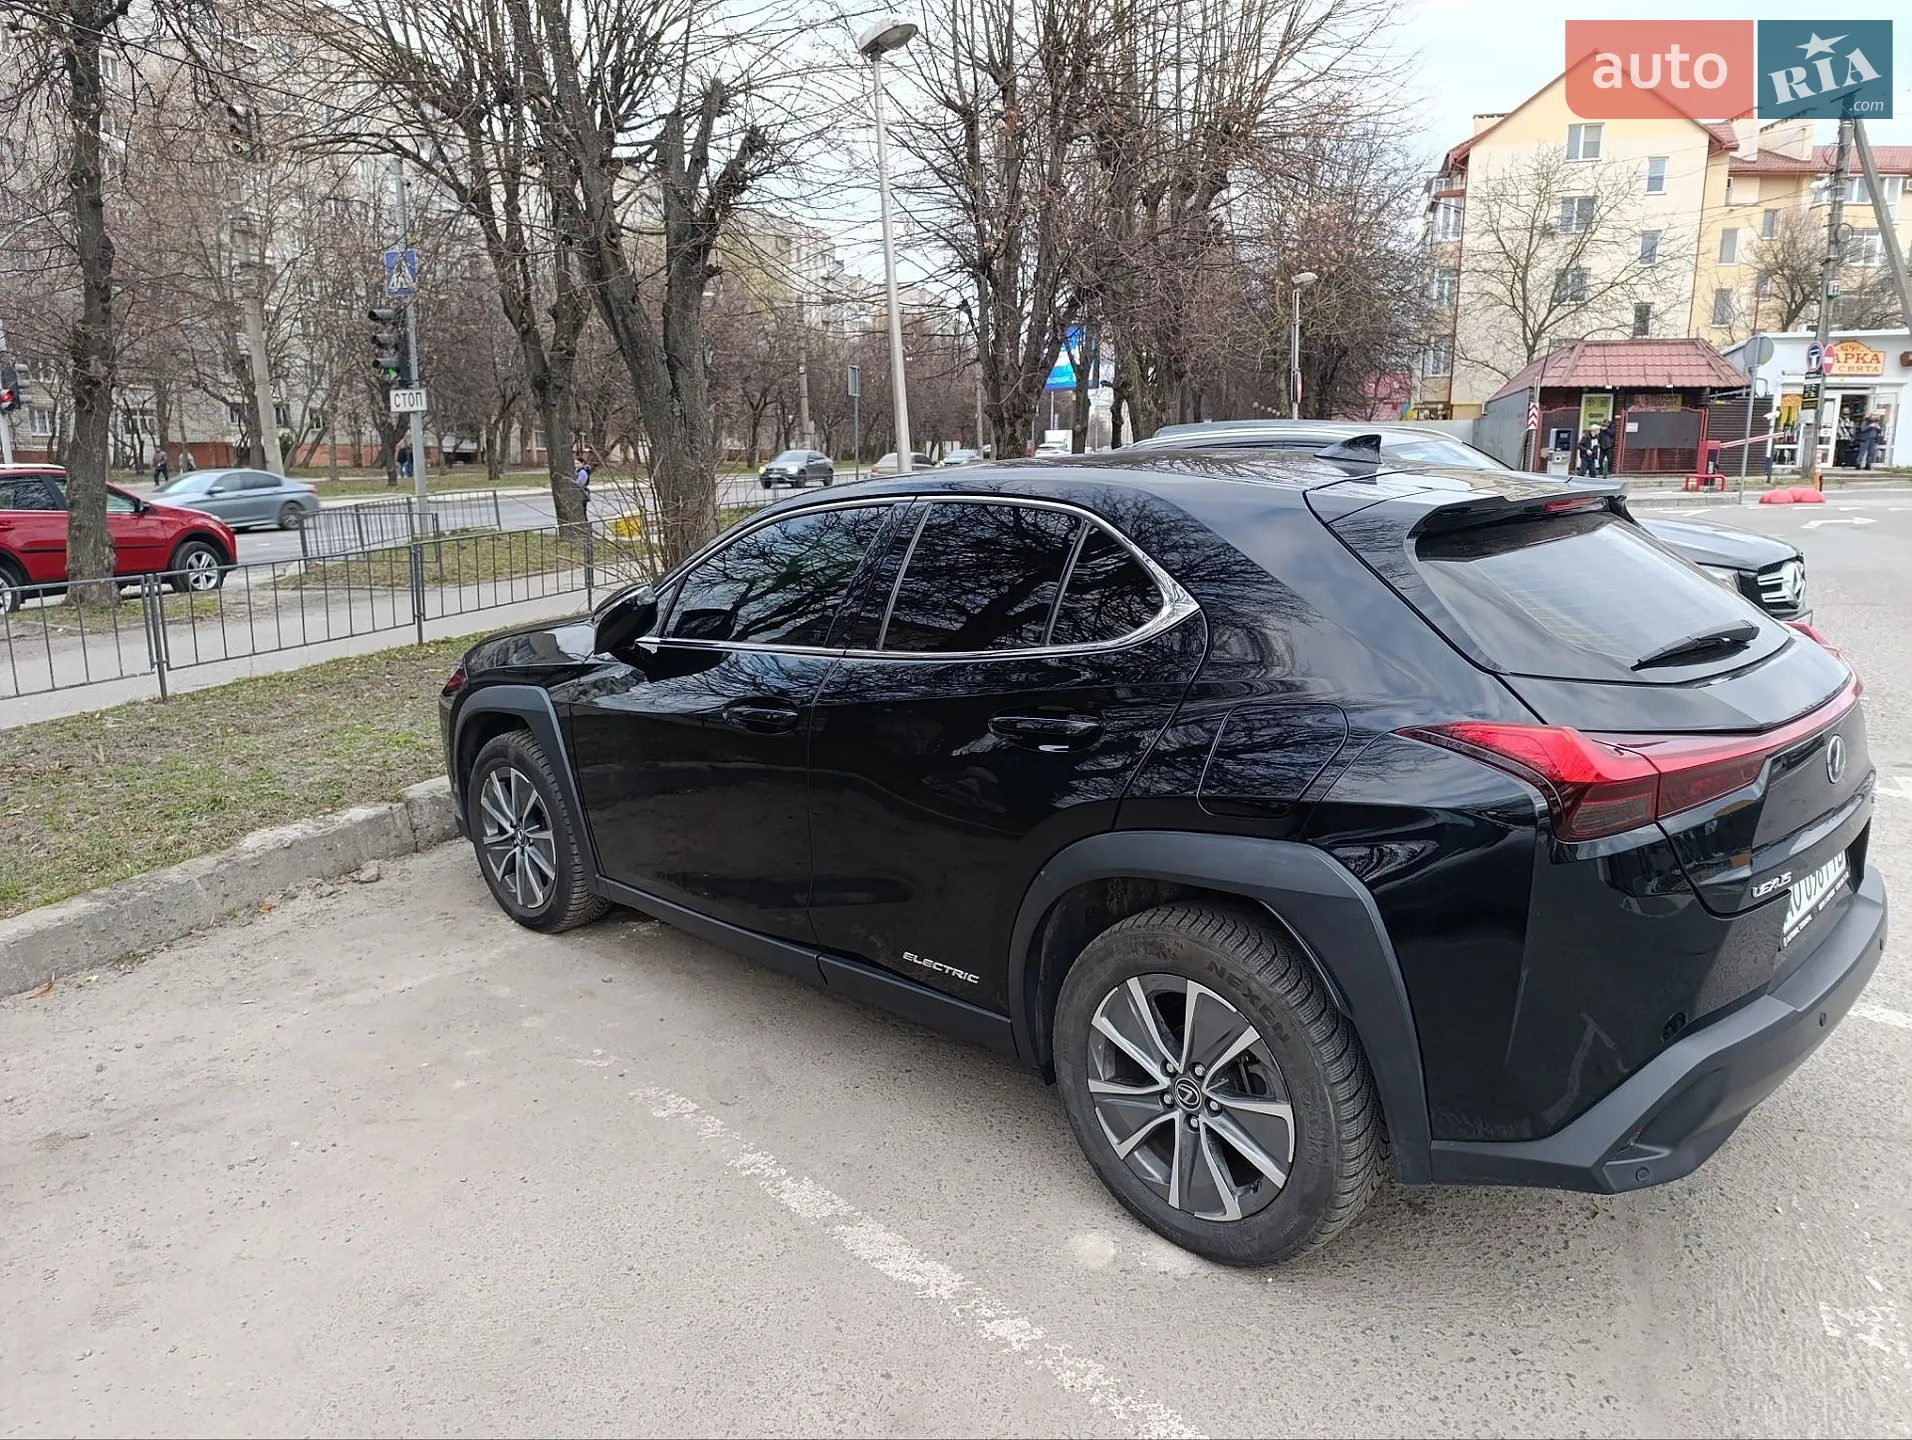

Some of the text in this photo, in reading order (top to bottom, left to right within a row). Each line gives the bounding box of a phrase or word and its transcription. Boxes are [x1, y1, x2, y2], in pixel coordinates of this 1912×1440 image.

[1838, 365, 1879, 373] СВЯТА
[394, 392, 423, 408] СТОП
[1752, 871, 1792, 898] LEXUS
[903, 951, 980, 984] ELECTRIC
[1205, 960, 1290, 1043] NEXEN
